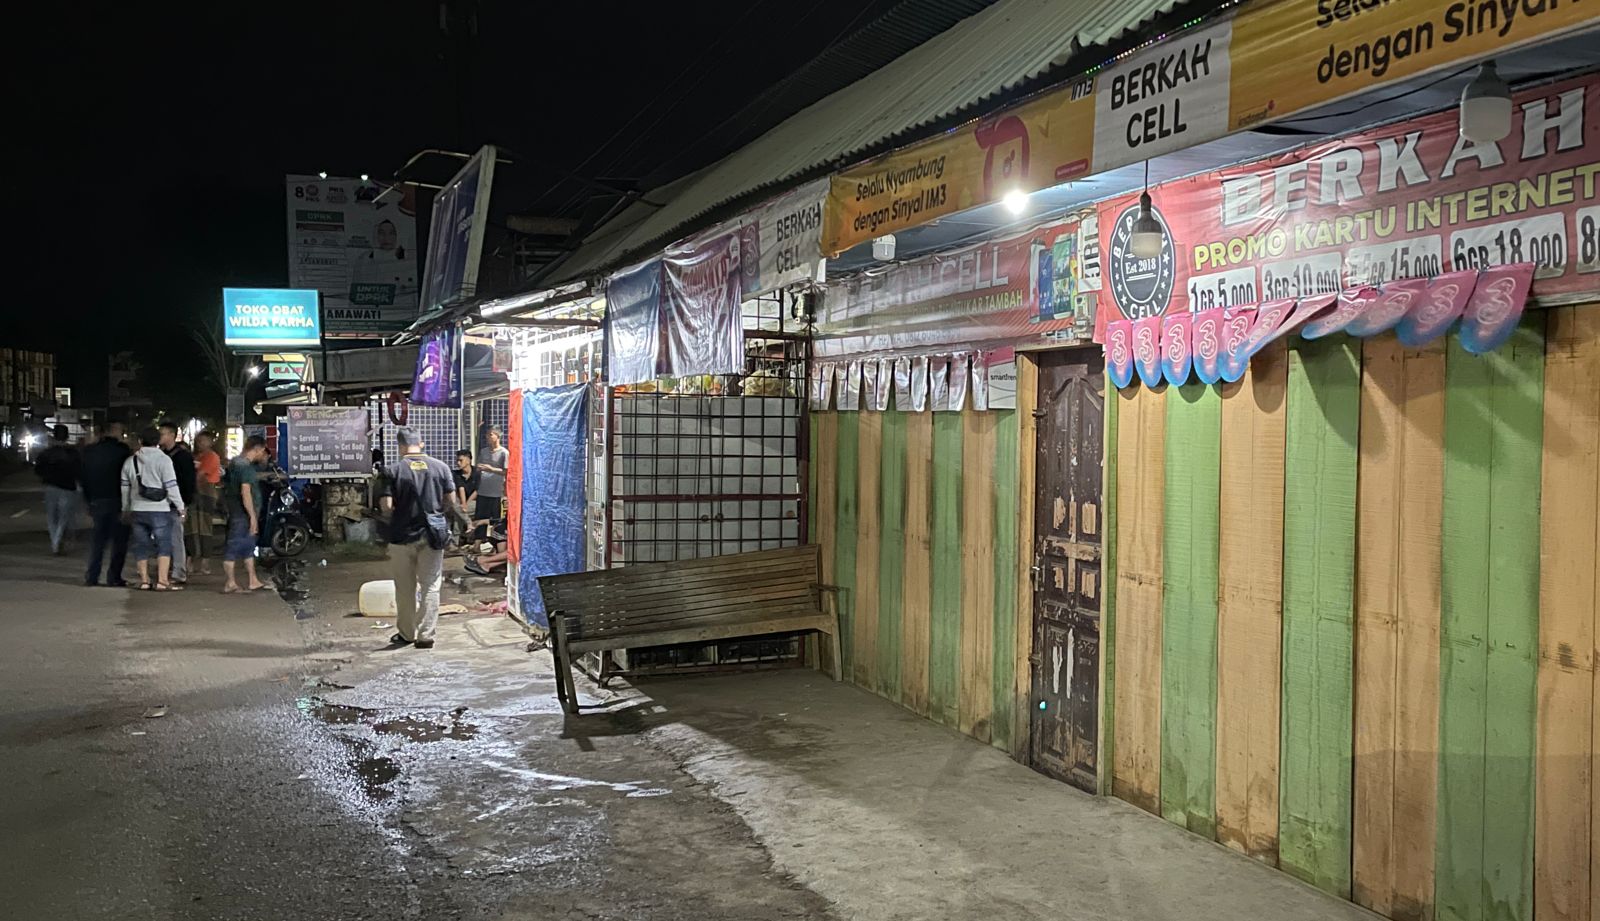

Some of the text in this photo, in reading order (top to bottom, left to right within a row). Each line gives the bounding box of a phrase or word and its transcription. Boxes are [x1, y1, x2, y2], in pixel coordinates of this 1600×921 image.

[1317, 21, 1433, 83] dengan
[1110, 38, 1212, 110] BERKAH
[1126, 98, 1187, 148] CELL
[1221, 86, 1586, 226] BERKAH
[856, 155, 946, 202] Selalu Nyambung
[295, 187, 304, 198] 8
[854, 184, 947, 232] dengan Sinyal IM3
[1194, 163, 1600, 271] PROMO KARTU INTERNET
[776, 202, 821, 242] BERKAH
[776, 245, 801, 274] CELL
[941, 245, 1009, 292] CELL
[1125, 257, 1157, 275] Est 2018
[355, 293, 390, 302] DPRK
[985, 289, 1023, 311] TAMBAH
[235, 304, 304, 315] TOKO OBAT
[1130, 300, 1161, 320] CELL
[229, 316, 269, 328] WILDA
[271, 316, 315, 328] FARMA
[990, 373, 1017, 381] smartfren
[299, 434, 319, 442] Service
[299, 443, 323, 452] Ganti Oli
[341, 442, 365, 453] Cet Body
[299, 453, 331, 462] Tambal Ban
[341, 452, 364, 462] Tune Up
[300, 462, 340, 472] Bongkar Mesin
